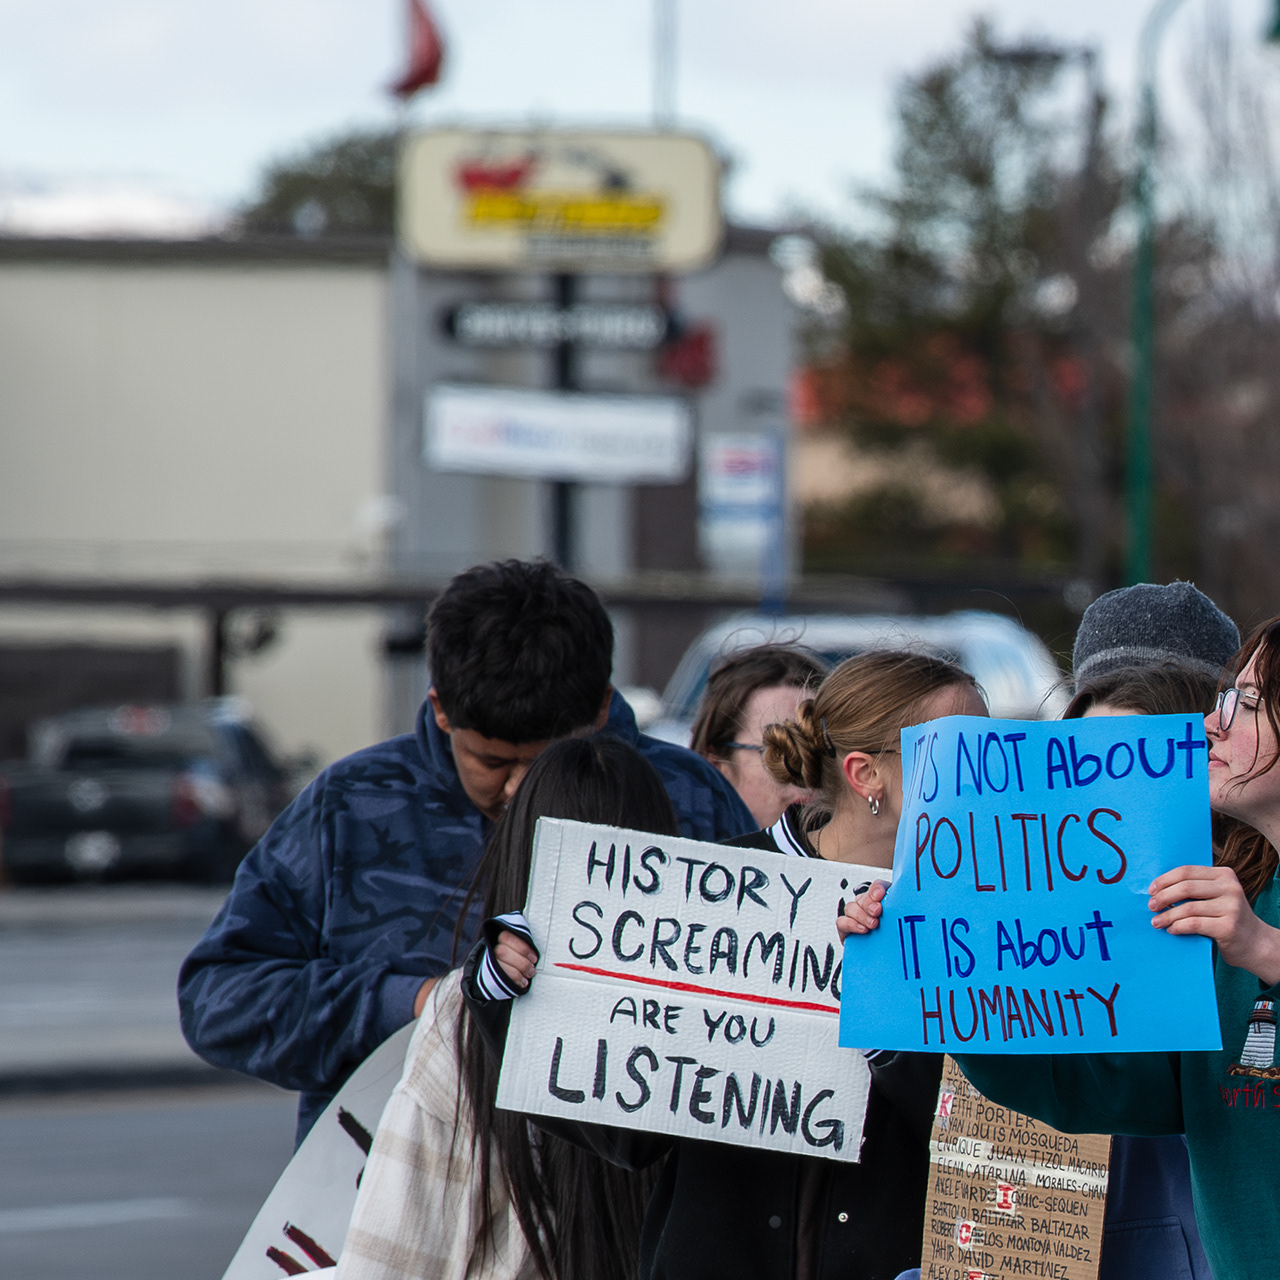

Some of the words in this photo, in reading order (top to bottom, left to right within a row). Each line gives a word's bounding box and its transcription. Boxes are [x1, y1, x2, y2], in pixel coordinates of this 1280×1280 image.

[955, 731, 1027, 797] NOT
[915, 807, 1128, 892] POLITICS
[586, 840, 813, 934] HISTORY
[898, 914, 926, 981] IT
[941, 917, 975, 979] IS
[610, 996, 684, 1035] ARE
[703, 1008, 776, 1048] YOU
[920, 982, 1121, 1046] HUMANITY
[548, 1036, 845, 1153] LISTENING
[976, 1103, 1036, 1129] PORTER
[937, 1133, 981, 1158] ENRIQUE
[987, 1143, 1027, 1163] JUAN
[1031, 1149, 1067, 1172] TIZOL
[1067, 1156, 1107, 1178] MACARIO
[941, 1115, 965, 1133] RYAN
[967, 1122, 1006, 1142] LOUIS
[1009, 1128, 1078, 1155] MOSQUEDA
[935, 1177, 954, 1197] AXEL
[937, 1157, 964, 1178] ELENA
[966, 1163, 1026, 1186] CATARINA
[932, 1200, 967, 1220] BARTOLO
[972, 1207, 1026, 1231] BALTAZAR
[1031, 1217, 1089, 1239] BALTAZAR
[931, 1238, 955, 1260] YAHIR
[958, 1248, 994, 1269] DAVID
[1000, 1255, 1070, 1280] MARTINEZ
[1006, 1234, 1050, 1255] MONTOYA
[1053, 1241, 1093, 1263] VALDEZ
